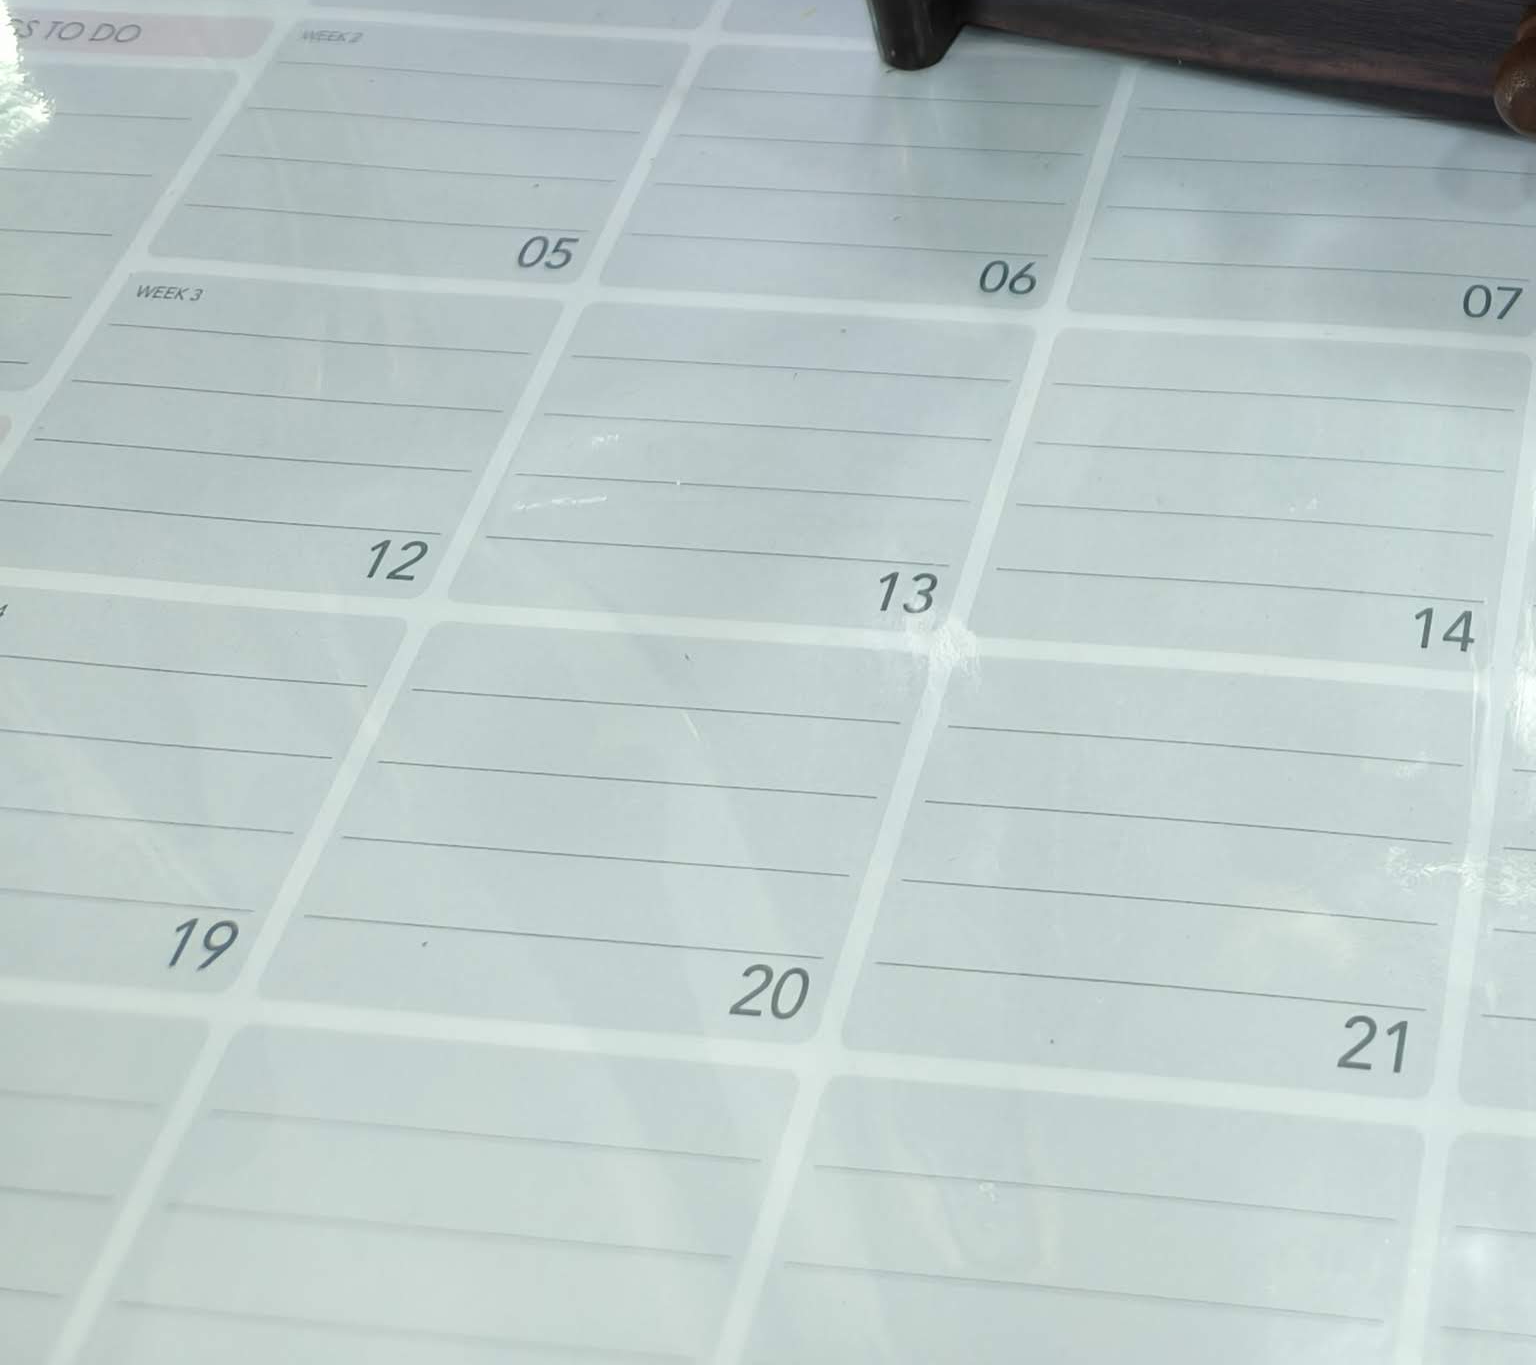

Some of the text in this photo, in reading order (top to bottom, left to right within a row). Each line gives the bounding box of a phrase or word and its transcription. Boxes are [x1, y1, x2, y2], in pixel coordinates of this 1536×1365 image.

[44, 20, 86, 42] TO
[87, 22, 143, 44] DO
[517, 236, 580, 271] 05
[136, 284, 204, 302] WEEK 3
[979, 260, 1037, 295] 06
[1463, 284, 1524, 320] 07
[366, 539, 428, 581] 12
[879, 571, 938, 613] 13
[1415, 607, 1475, 653] 14
[167, 918, 240, 971] 19
[729, 963, 810, 1020] 20
[1336, 1014, 1409, 1074] 21
